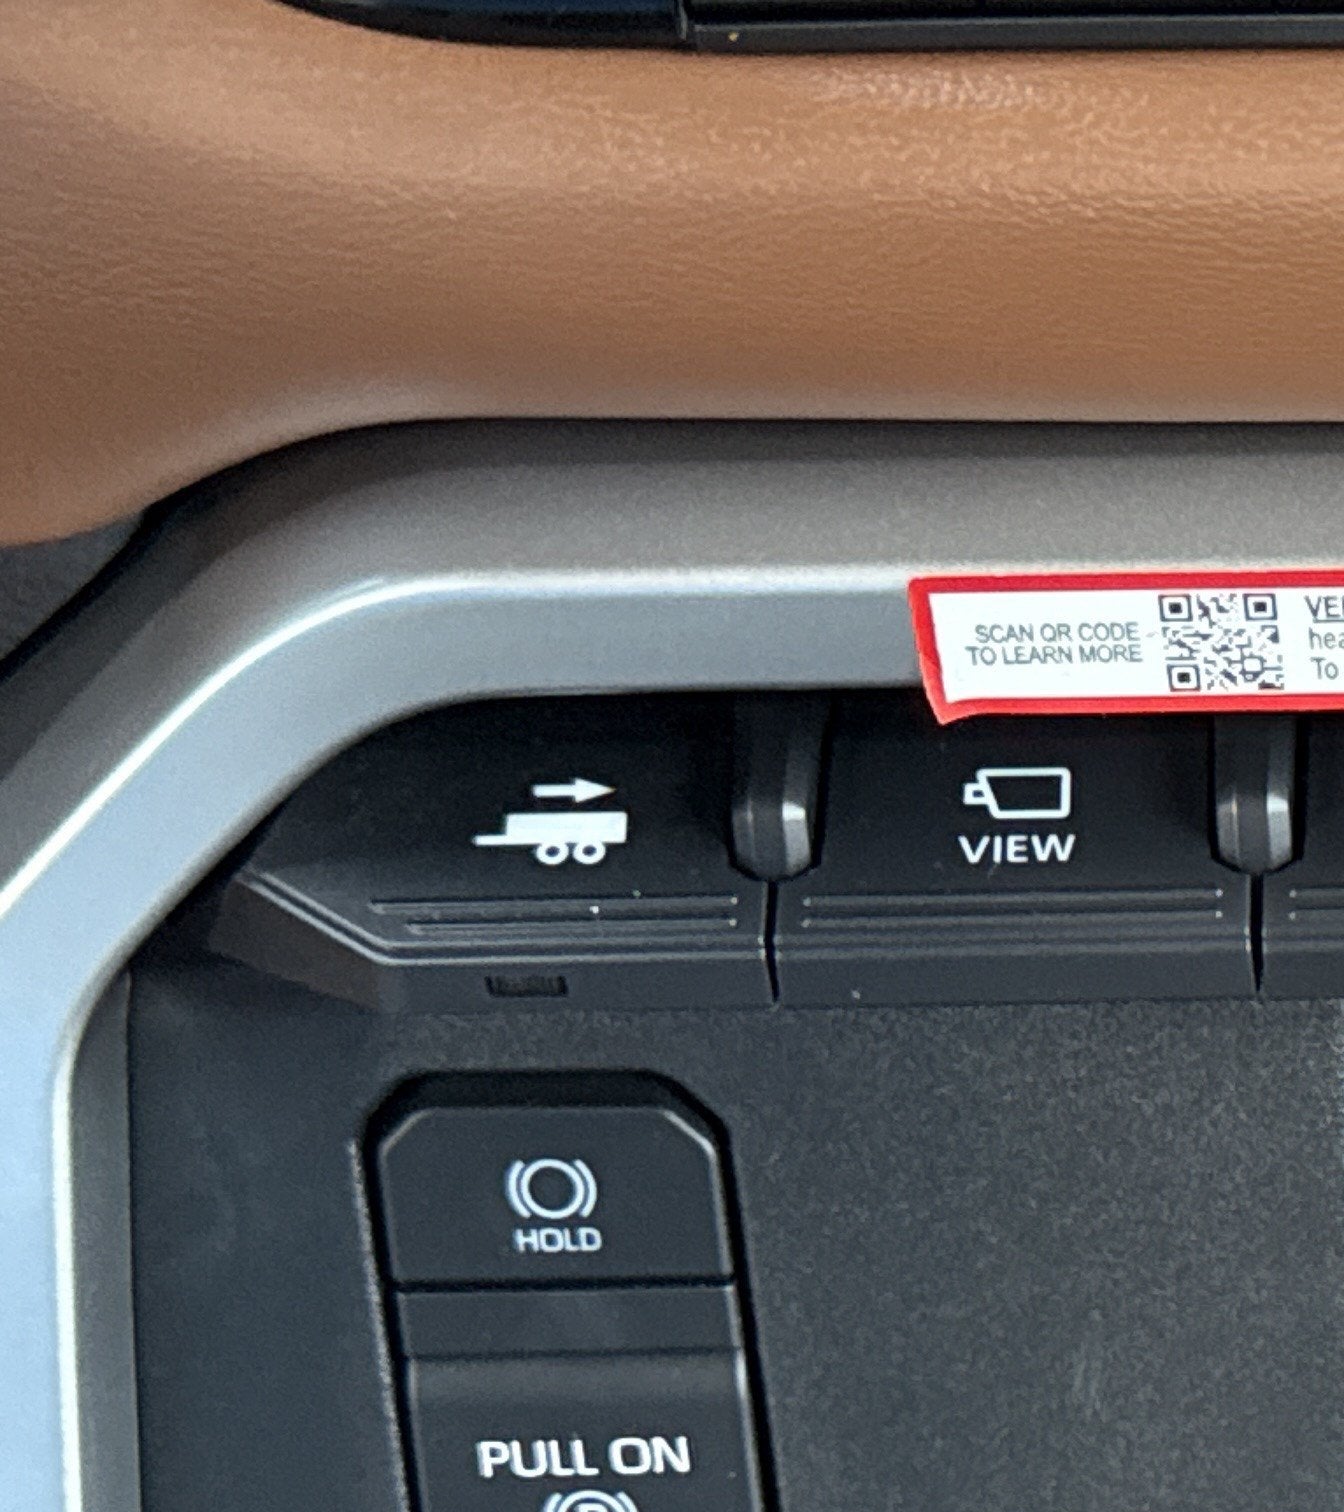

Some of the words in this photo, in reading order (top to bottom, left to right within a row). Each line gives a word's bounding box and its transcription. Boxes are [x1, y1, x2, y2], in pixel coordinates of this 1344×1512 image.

[975, 624, 1034, 643] SCAN
[1040, 623, 1073, 643] QR
[1078, 622, 1140, 641] CODE
[965, 646, 997, 666] TO
[1002, 646, 1073, 665] LEARN
[1079, 644, 1143, 663] MORE
[1310, 657, 1339, 680] To
[959, 834, 1075, 863] VIEW
[515, 1227, 602, 1252] HOLD
[477, 1440, 599, 1477] PULL
[609, 1436, 690, 1474] ON
